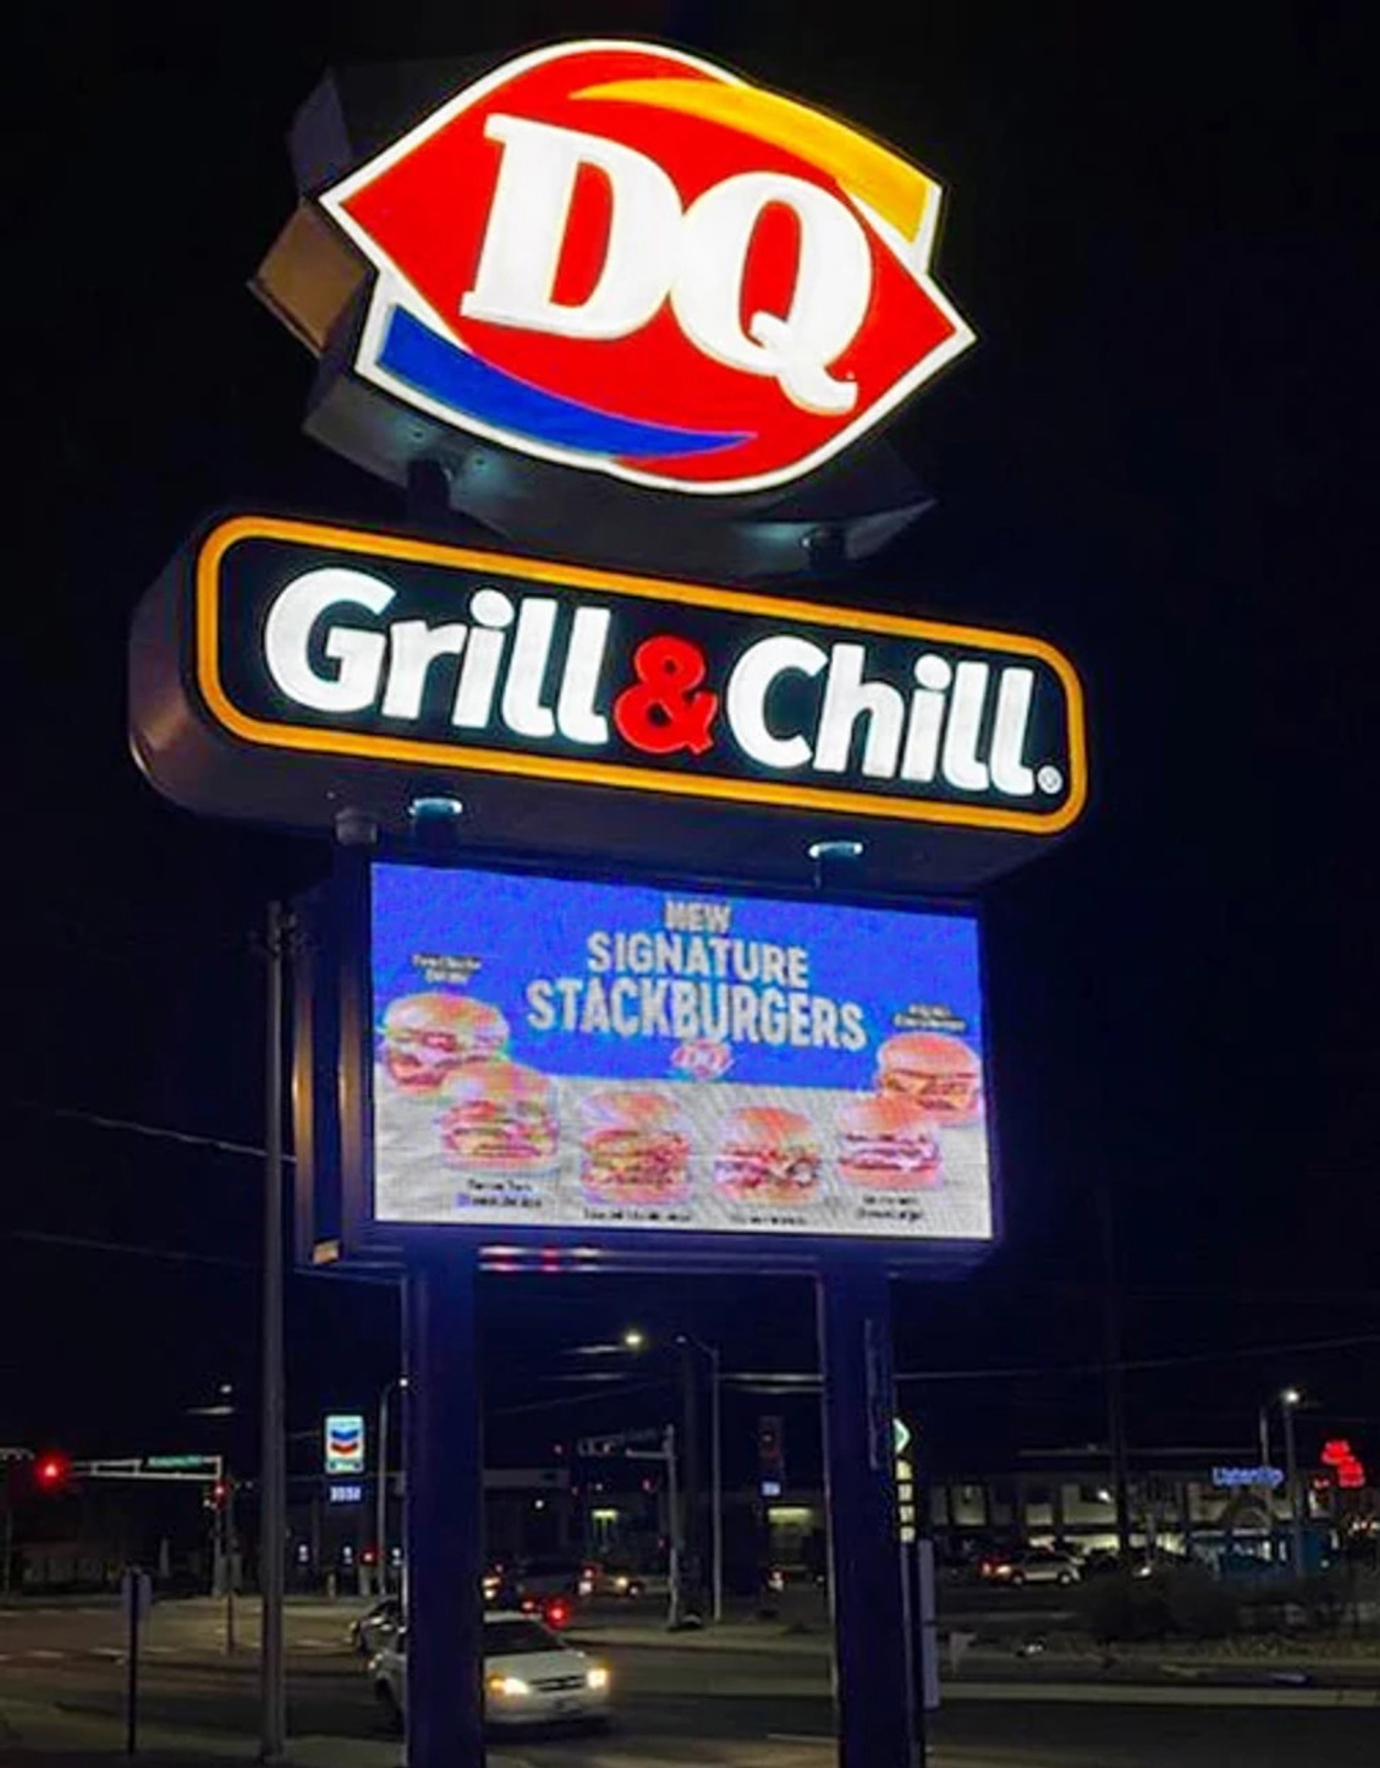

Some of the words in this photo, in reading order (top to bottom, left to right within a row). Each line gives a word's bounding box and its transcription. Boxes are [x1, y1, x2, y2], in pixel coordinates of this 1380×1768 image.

[461, 113, 873, 416] DQ
[665, 899, 731, 934] NEW
[586, 931, 809, 989] SIGNATURE
[526, 976, 868, 1051] STACKBURGERS
